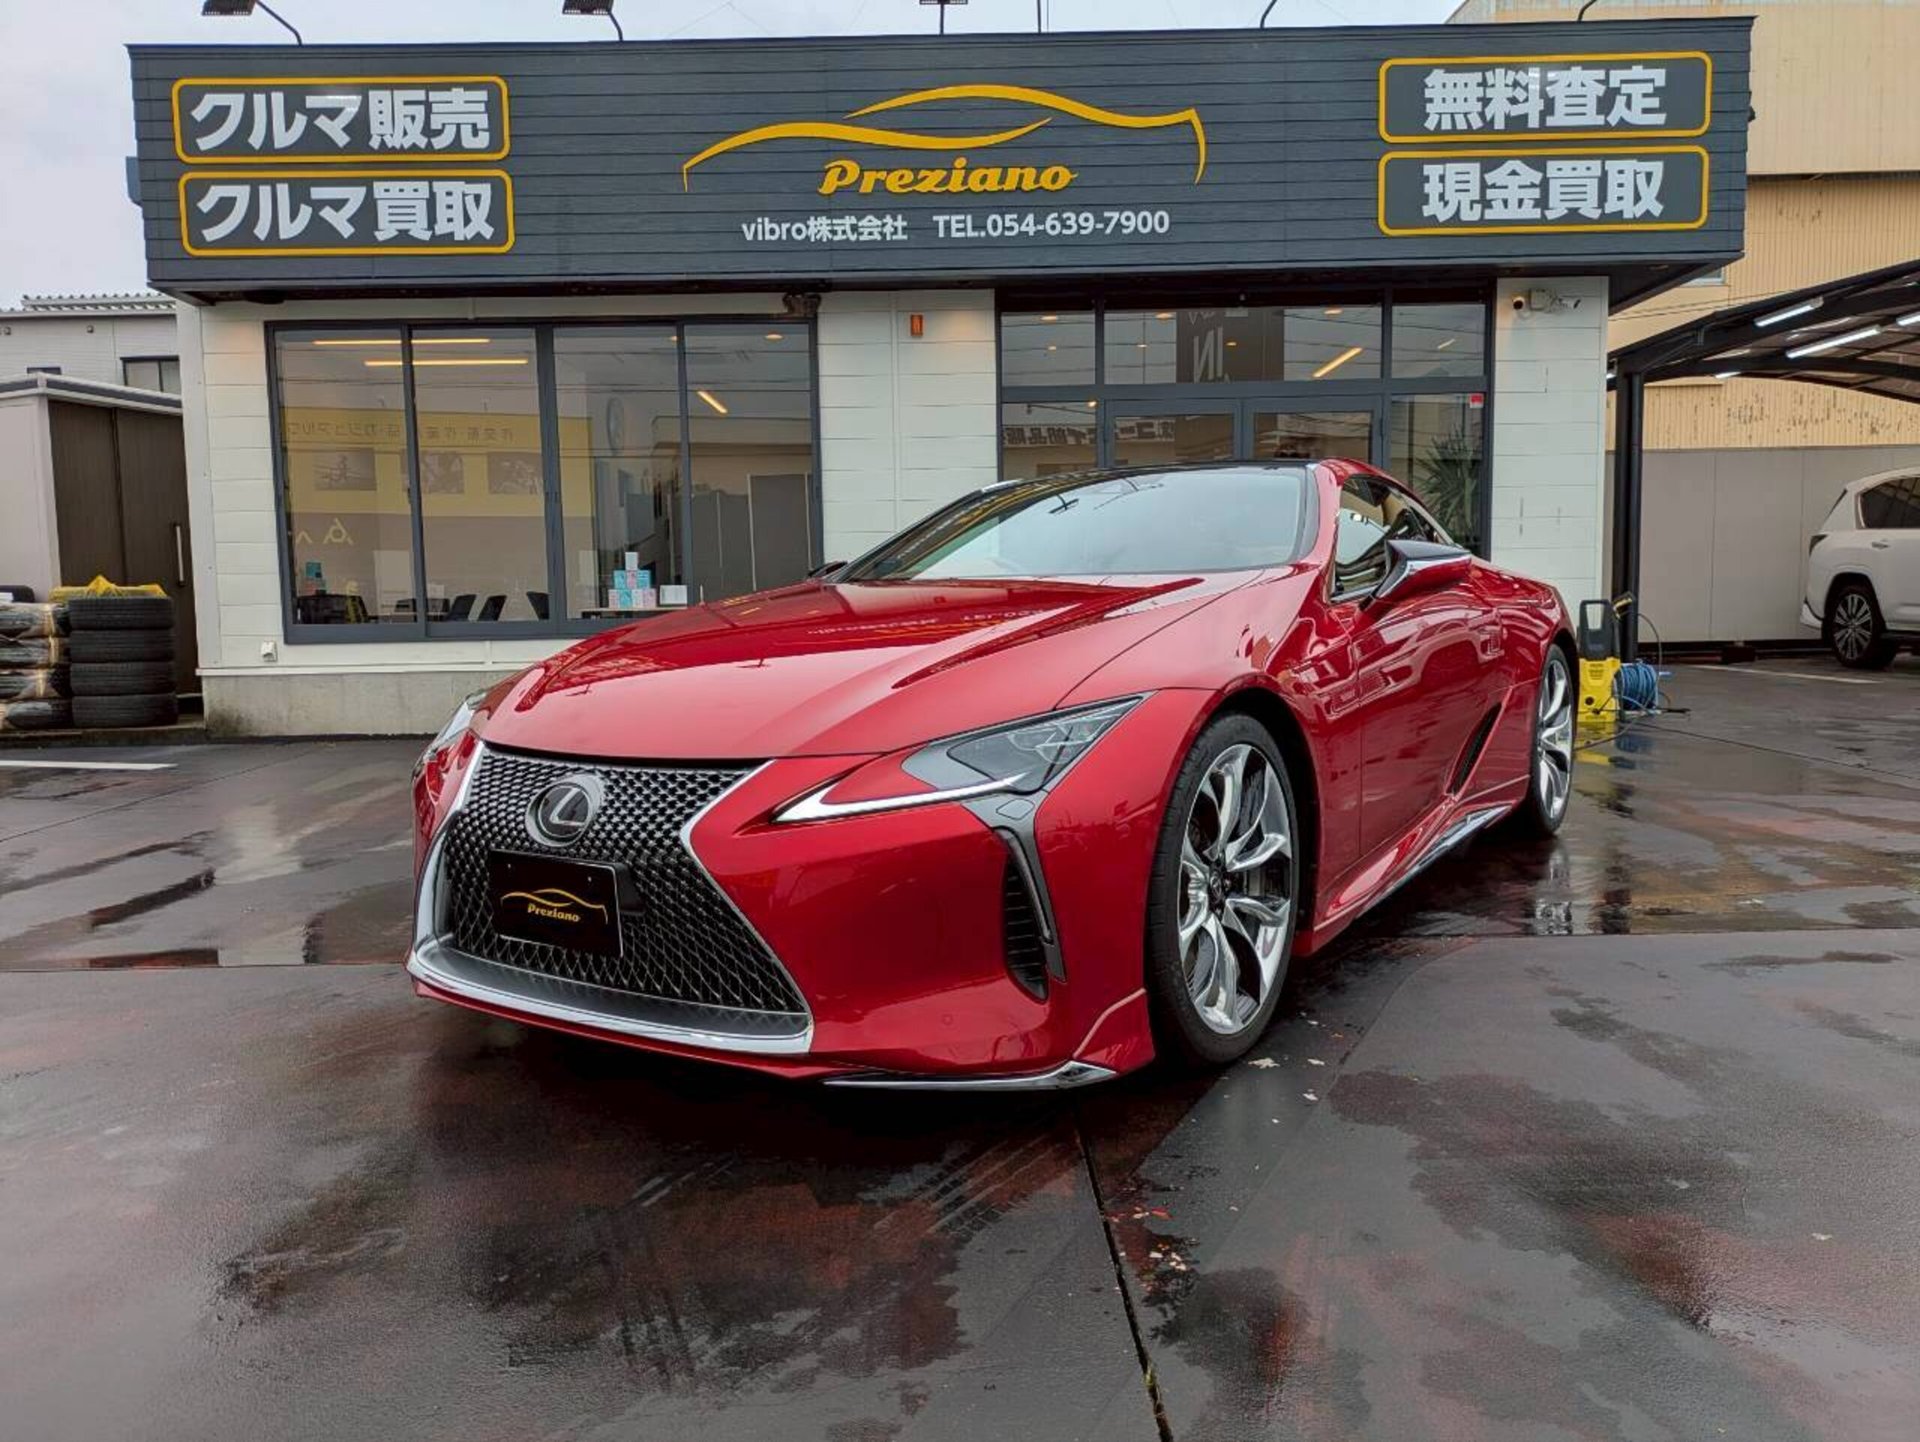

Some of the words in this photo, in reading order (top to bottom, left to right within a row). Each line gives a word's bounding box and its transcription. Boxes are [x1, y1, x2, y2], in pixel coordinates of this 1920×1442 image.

[190, 87, 490, 151] クルマ販売
[1423, 64, 1667, 131] 無料査定
[819, 156, 1078, 196] Preziano
[1421, 159, 1664, 223] 現金買取
[196, 180, 495, 242] クルマ買取
[741, 214, 908, 243] vibro株式会社
[932, 210, 1170, 239] TEL.054-639-7900
[527, 903, 580, 922] Preziano
